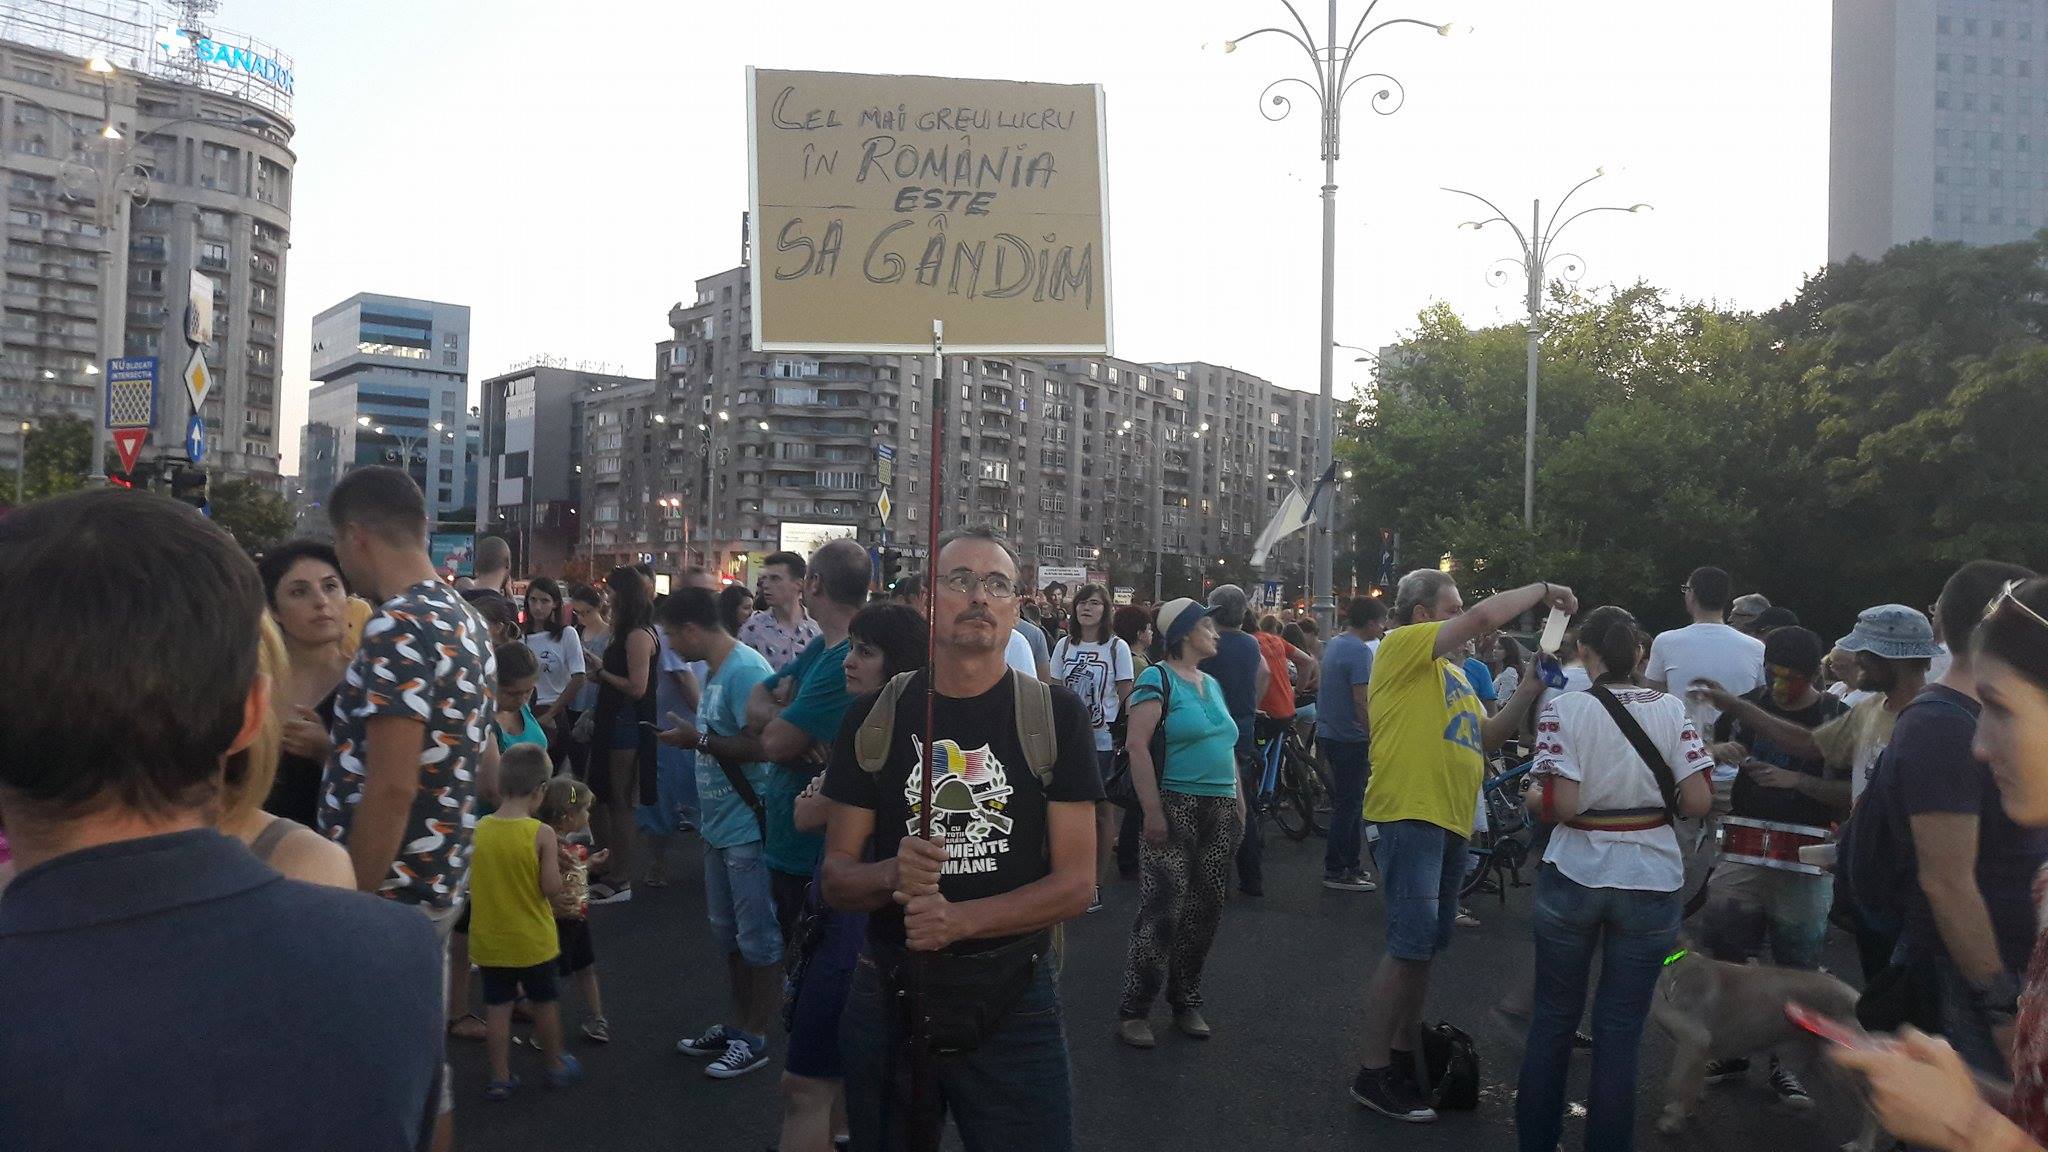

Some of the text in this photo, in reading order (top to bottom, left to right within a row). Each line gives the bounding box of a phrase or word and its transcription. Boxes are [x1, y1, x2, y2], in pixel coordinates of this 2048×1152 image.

[197, 38, 294, 95] SANADOR
[771, 86, 1075, 131] CEL MAI GREU LUCRU
[803, 135, 1058, 189] ÎN ROMÂNIA
[894, 186, 997, 215] ESTE
[774, 213, 1093, 311] SA GÂNDIM
[112, 360, 126, 371] NU
